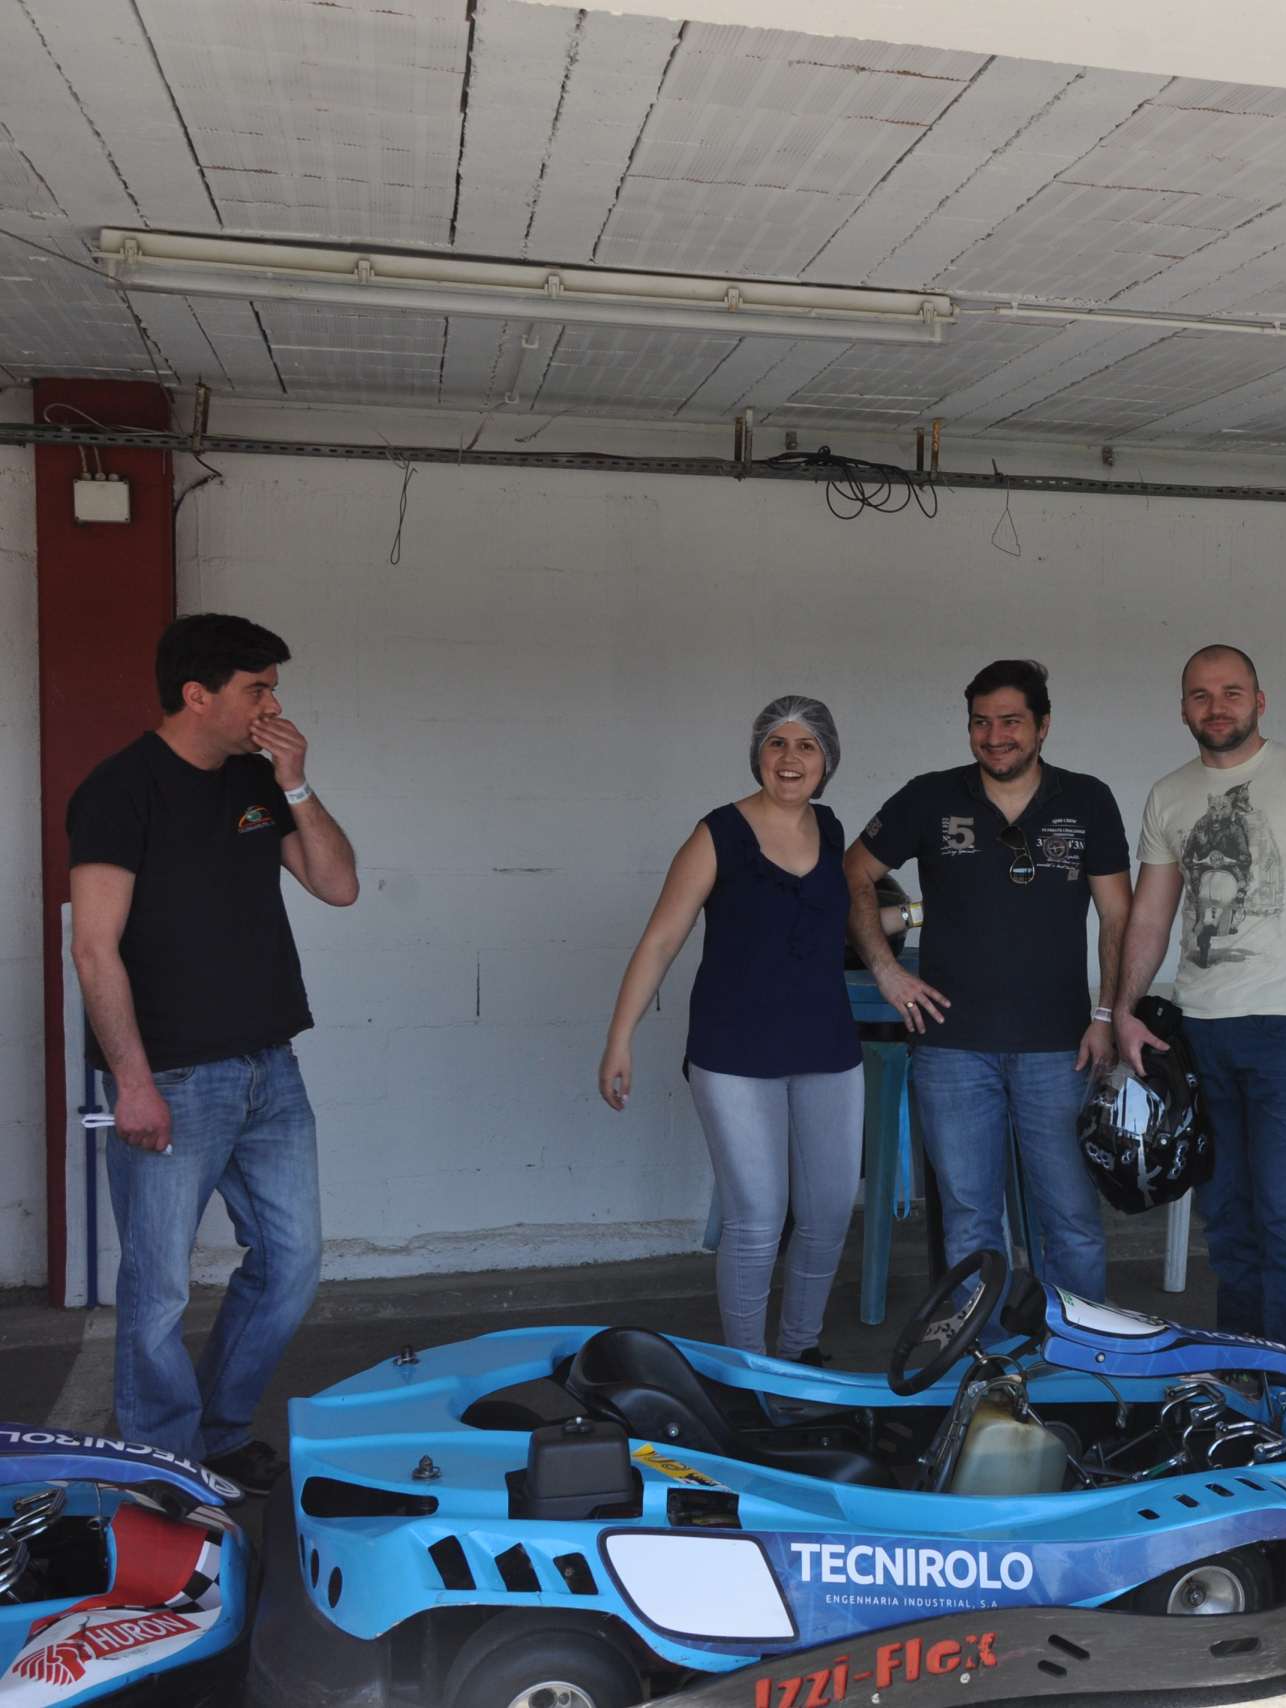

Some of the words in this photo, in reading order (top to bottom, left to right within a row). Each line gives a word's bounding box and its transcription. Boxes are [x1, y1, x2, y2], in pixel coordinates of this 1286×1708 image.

[791, 1543, 1033, 1590] TECNIROLO
[825, 1594, 899, 1606] ENGENHARIA
[904, 1597, 976, 1609] INDUSTRIAL,
[85, 1615, 188, 1650] HURON
